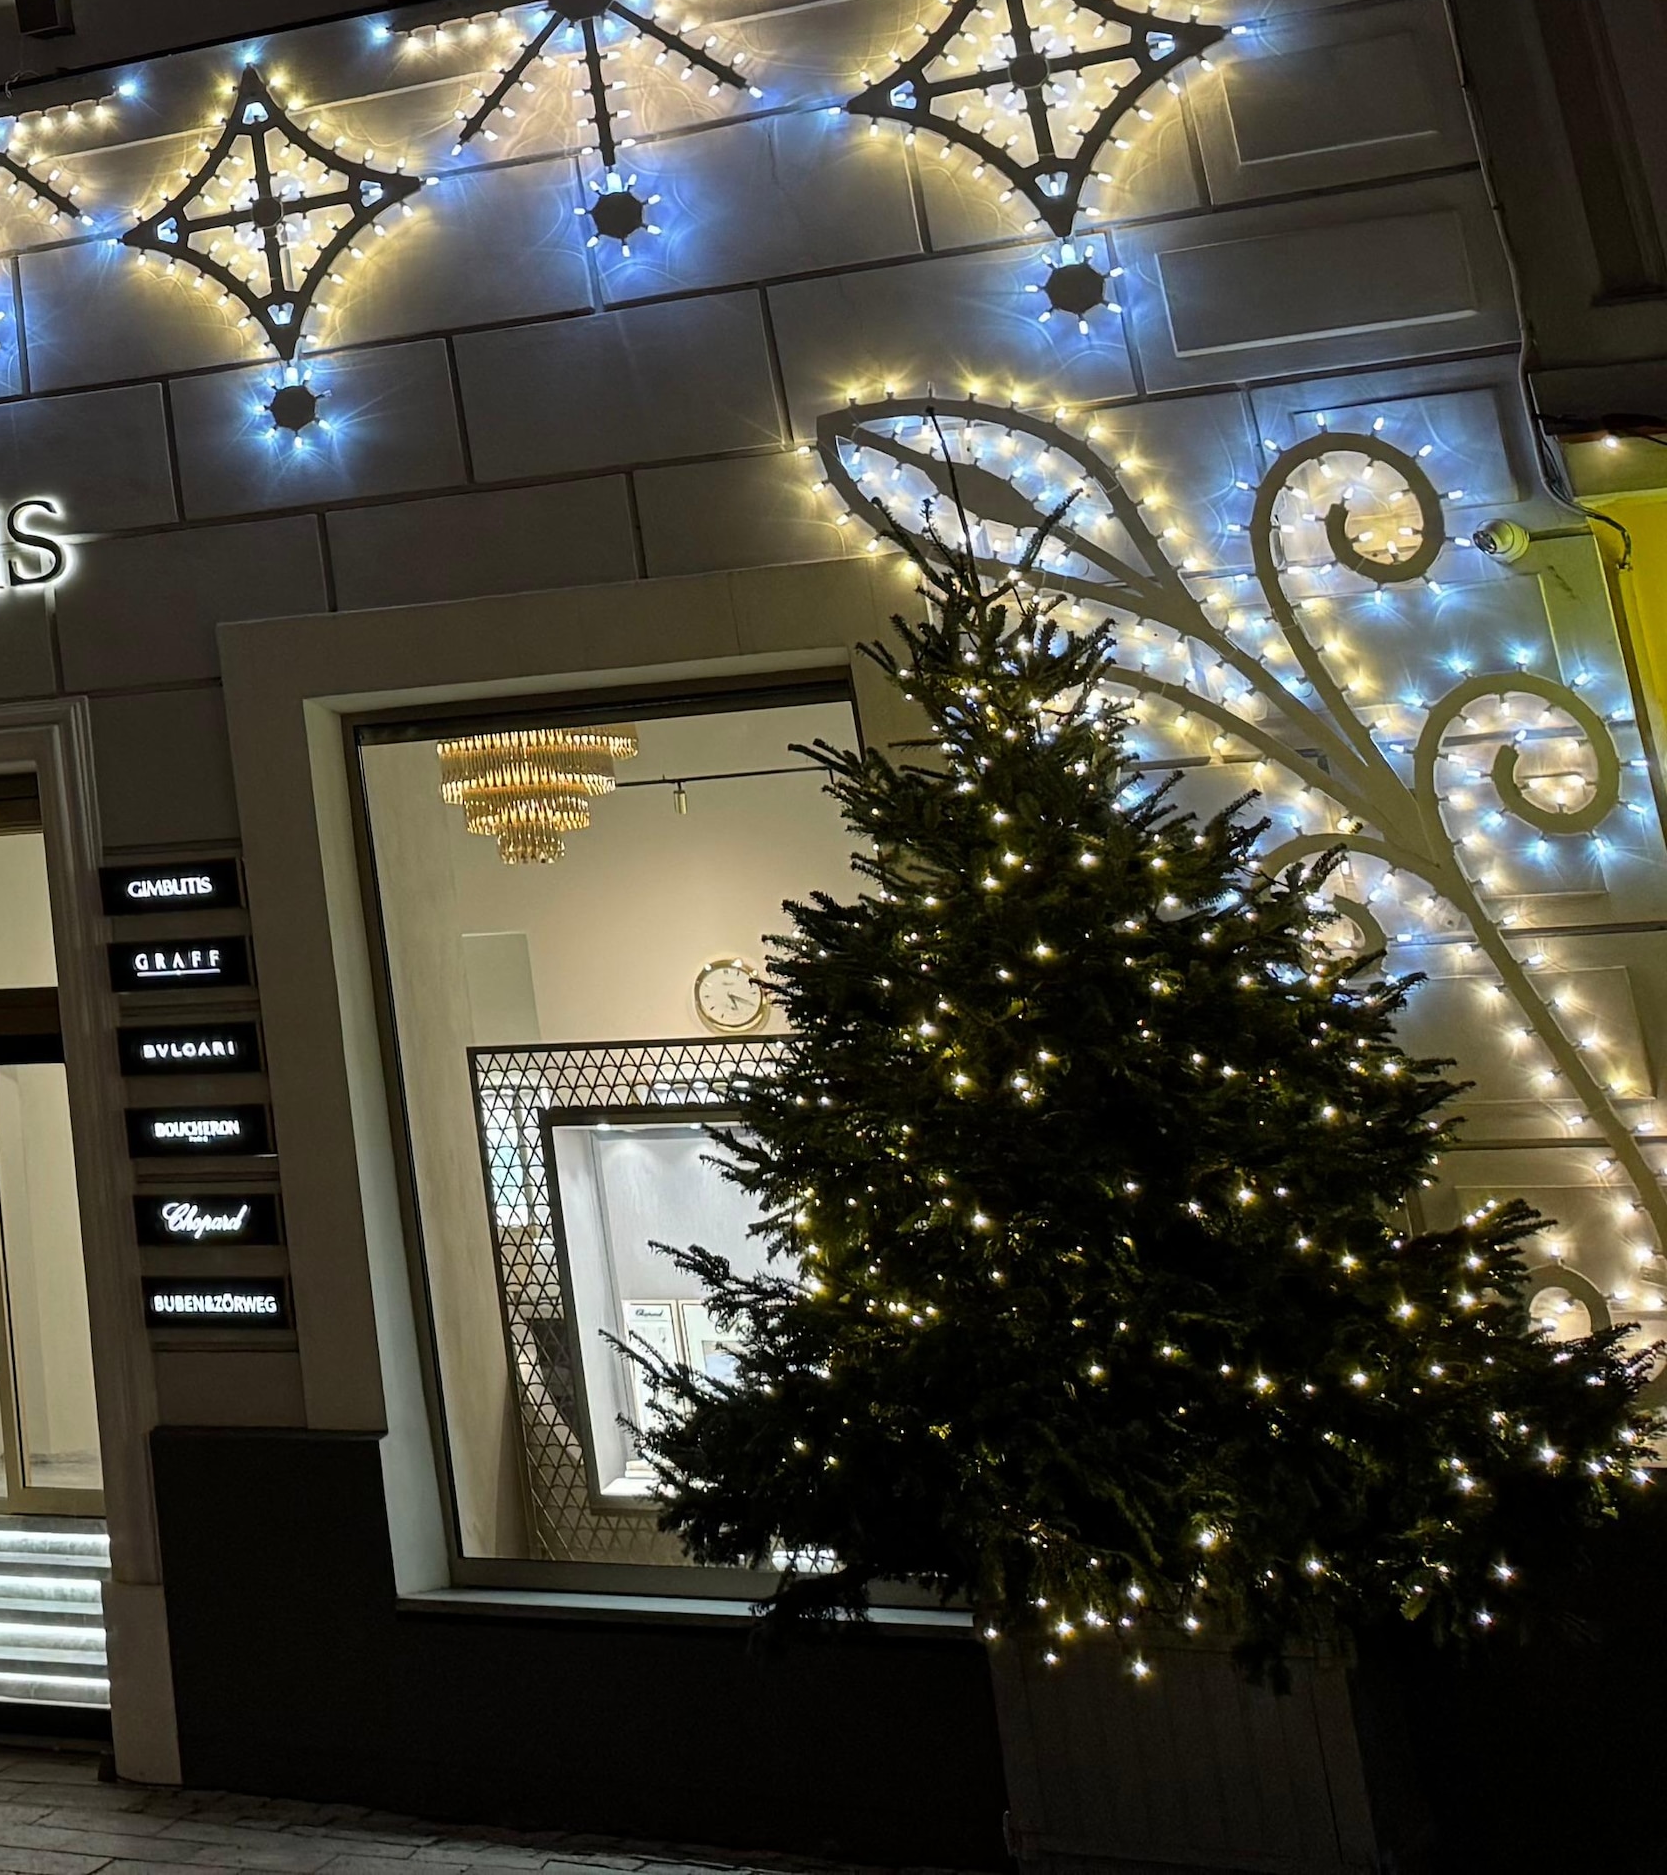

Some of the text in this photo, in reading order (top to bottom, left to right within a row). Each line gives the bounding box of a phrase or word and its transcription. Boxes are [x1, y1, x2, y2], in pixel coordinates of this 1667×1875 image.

[127, 876, 212, 898] GIMBUTIS
[134, 949, 221, 971] GRAFF
[142, 1040, 235, 1059] BVLGARI
[154, 1120, 240, 1138] BOUCHERON
[161, 1202, 249, 1240] Chopard
